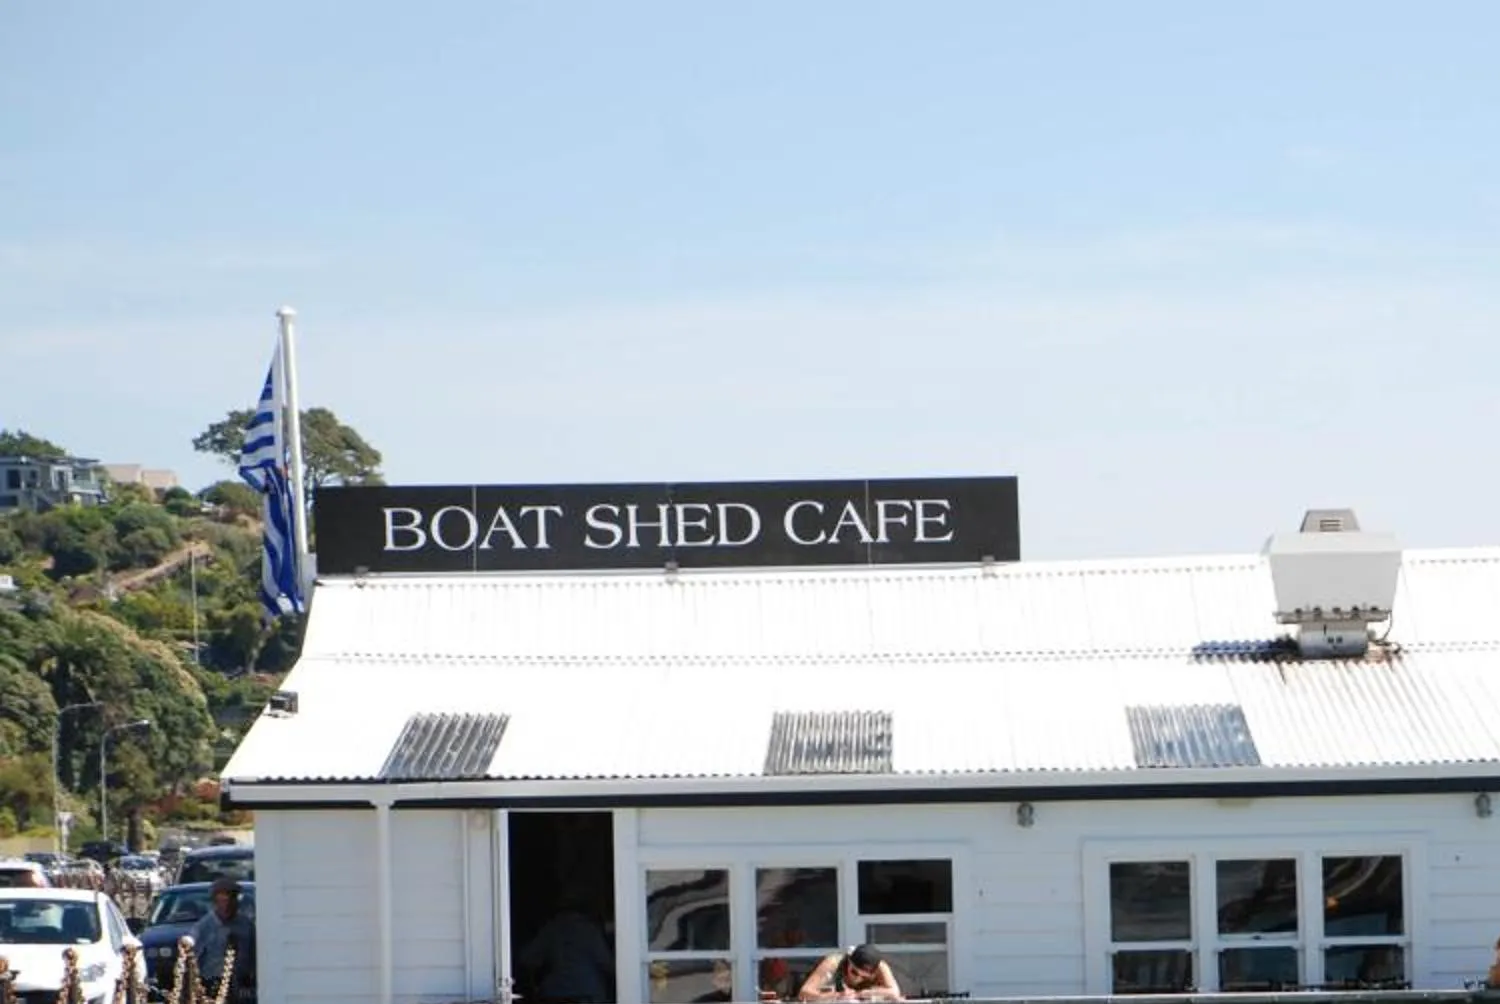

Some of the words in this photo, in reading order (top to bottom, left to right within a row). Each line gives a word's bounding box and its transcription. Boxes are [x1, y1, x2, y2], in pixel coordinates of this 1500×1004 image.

[382, 505, 563, 551] BOAT
[584, 502, 761, 549] SHED
[783, 499, 953, 545] CAFE
